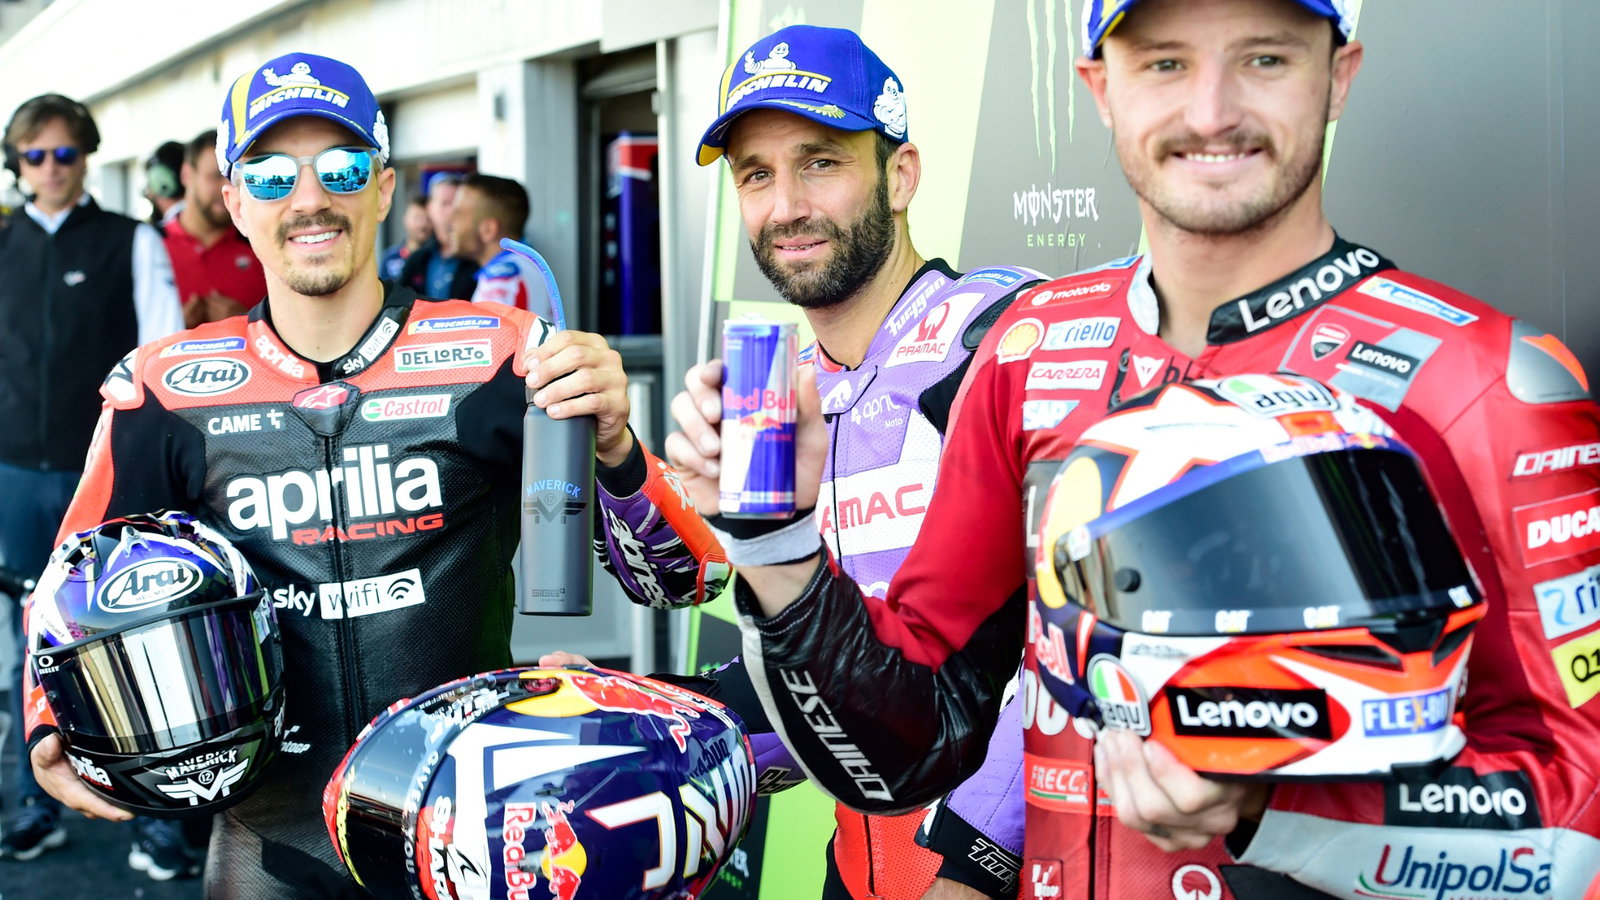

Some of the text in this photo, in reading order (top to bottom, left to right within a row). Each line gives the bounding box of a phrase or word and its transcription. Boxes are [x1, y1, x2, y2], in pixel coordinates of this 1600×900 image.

[249, 88, 349, 120] MICHELIN
[726, 74, 829, 112] MICHELIN
[1013, 183, 1099, 226] MONSTER
[1027, 233, 1086, 247] ENERGY
[1052, 283, 1111, 300] motorola
[1238, 248, 1379, 333] Lenovo
[433, 319, 493, 330] MICHELIN
[1065, 321, 1116, 342] riello
[255, 334, 305, 379] aprilia
[896, 342, 946, 358] PRAMAC
[1351, 343, 1411, 373] Lenovo
[175, 363, 239, 386] Arai
[342, 357, 365, 376] sky
[1031, 367, 1100, 380] CARRERA
[384, 398, 444, 417] Castrol
[723, 387, 760, 410] Red
[207, 413, 262, 436] CAME
[885, 418, 903, 429] Moto
[1024, 401, 1069, 429] SAP
[1513, 444, 1600, 476] DAINE
[226, 444, 443, 541] aprilia
[526, 479, 581, 498] MAVERICK
[820, 483, 926, 535] AMAC
[291, 513, 444, 545] RACING
[1527, 508, 1600, 549] DUCA
[108, 562, 189, 607] Arai
[273, 583, 381, 616] sky wifi
[1176, 695, 1319, 728] Lenovo
[780, 668, 894, 801] DAINESE
[166, 750, 237, 780] MAVERICK
[1400, 783, 1527, 816] Lenovo
[428, 795, 460, 900] SHAR
[1374, 844, 1551, 900] UnipolSa
